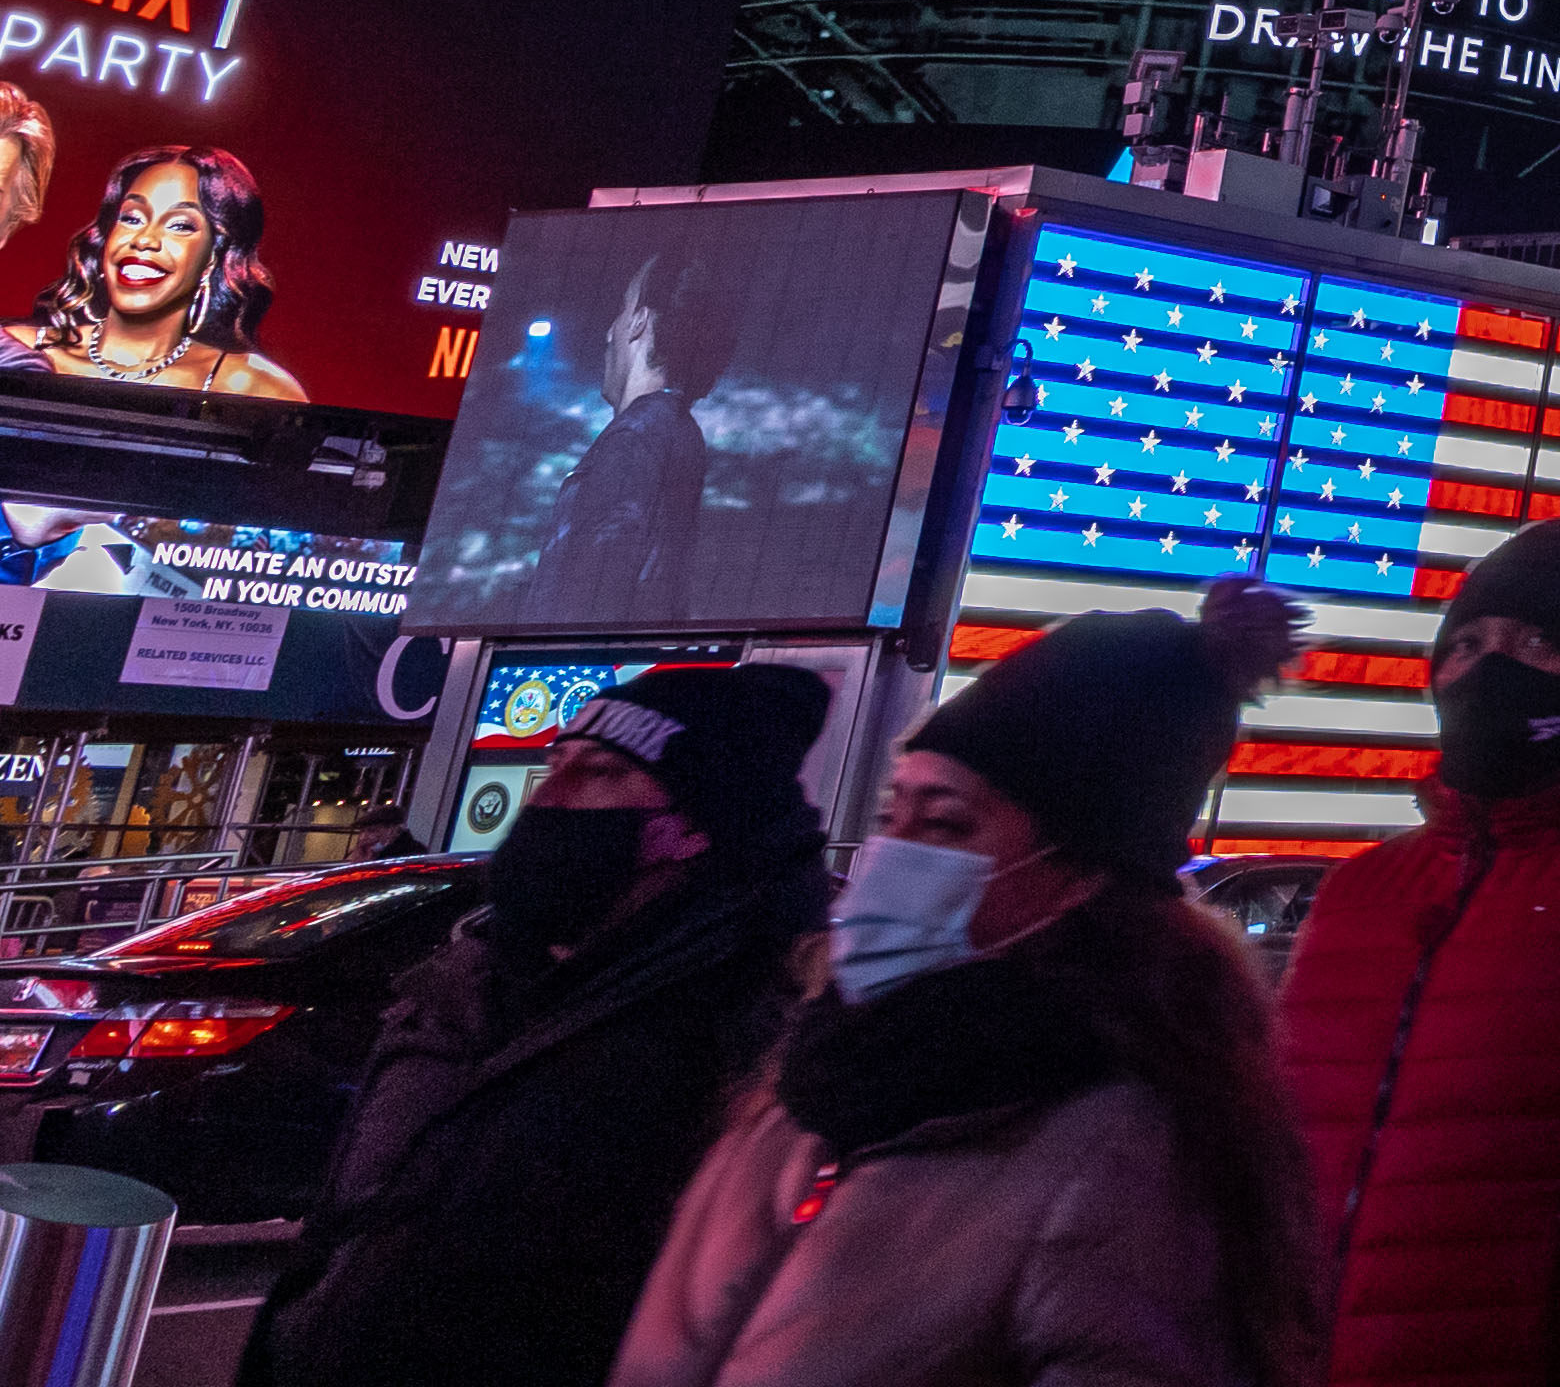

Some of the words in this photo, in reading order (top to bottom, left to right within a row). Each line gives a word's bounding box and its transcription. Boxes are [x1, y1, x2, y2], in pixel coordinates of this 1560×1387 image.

[0, 13, 241, 102] PARTY
[150, 542, 287, 576] NOMINATE
[286, 556, 327, 580] AN
[201, 576, 232, 601] IN
[236, 580, 307, 608] YOUR
[151, 615, 181, 629] New
[173, 601, 202, 615] 1500
[203, 603, 262, 621] Broadway
[136, 647, 188, 662] RELATED
[188, 650, 243, 665] SERVICES
